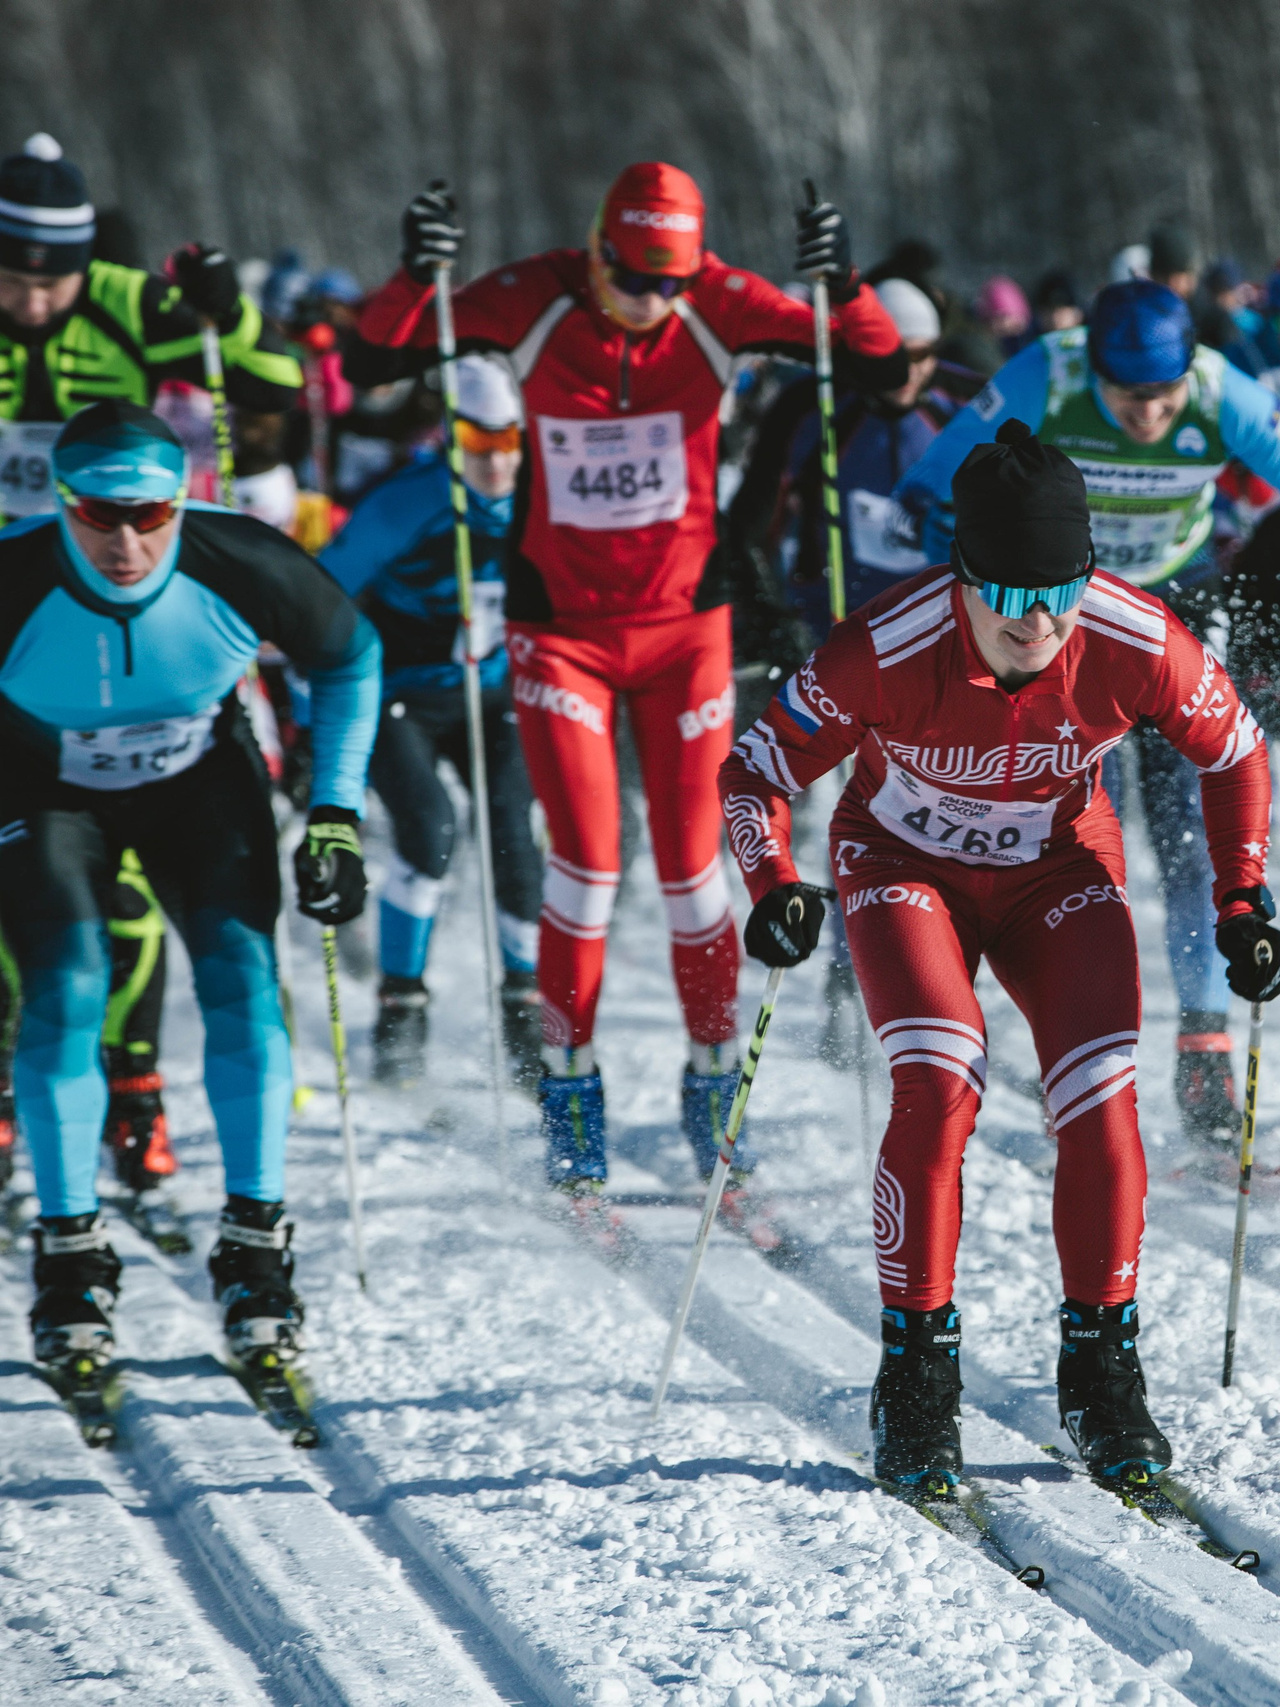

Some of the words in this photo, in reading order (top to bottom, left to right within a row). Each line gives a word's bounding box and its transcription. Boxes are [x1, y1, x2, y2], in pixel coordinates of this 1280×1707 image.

[568, 457, 663, 501] 4484
[939, 796, 992, 812] ЛЫЖНЯ
[902, 806, 1021, 854] 4769
[846, 885, 934, 916] LUKOIL
[1044, 884, 1131, 930] BOSCO
